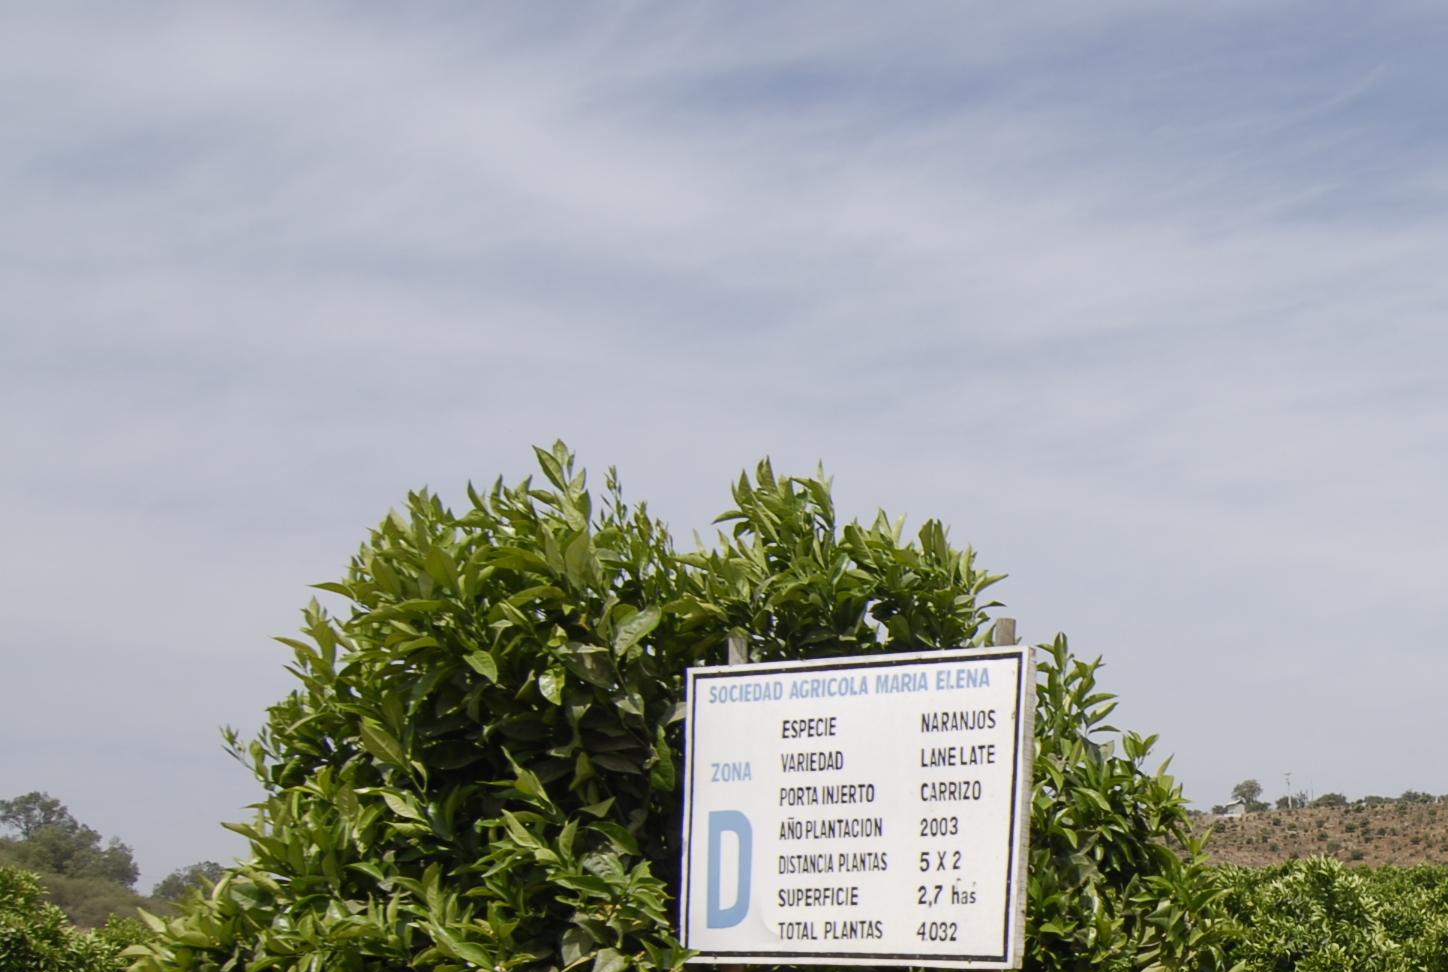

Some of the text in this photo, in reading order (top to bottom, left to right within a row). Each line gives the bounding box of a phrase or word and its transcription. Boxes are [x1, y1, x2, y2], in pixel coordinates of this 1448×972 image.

[709, 668, 990, 703] SOCIEDAD AGRICOLA MARIA ELENA
[782, 717, 837, 739] ESPECIE
[921, 710, 996, 733] NARANJOS
[781, 751, 843, 773] VARIEDAD
[921, 745, 996, 767] LANE LATE
[711, 762, 752, 782] ZONA
[780, 784, 875, 806] PORTA INJERTO
[920, 781, 982, 801] CARRIZO
[779, 818, 882, 840] AÑO PLANTACION
[920, 817, 959, 836] 2003
[706, 810, 752, 929] D
[779, 852, 887, 874] DISTANCIA PLANTAS
[919, 851, 961, 871] 5 X 2
[778, 887, 858, 907] SUPERFICIE
[918, 886, 942, 907] 2,7
[778, 921, 883, 940] TOTAL PLANTAS
